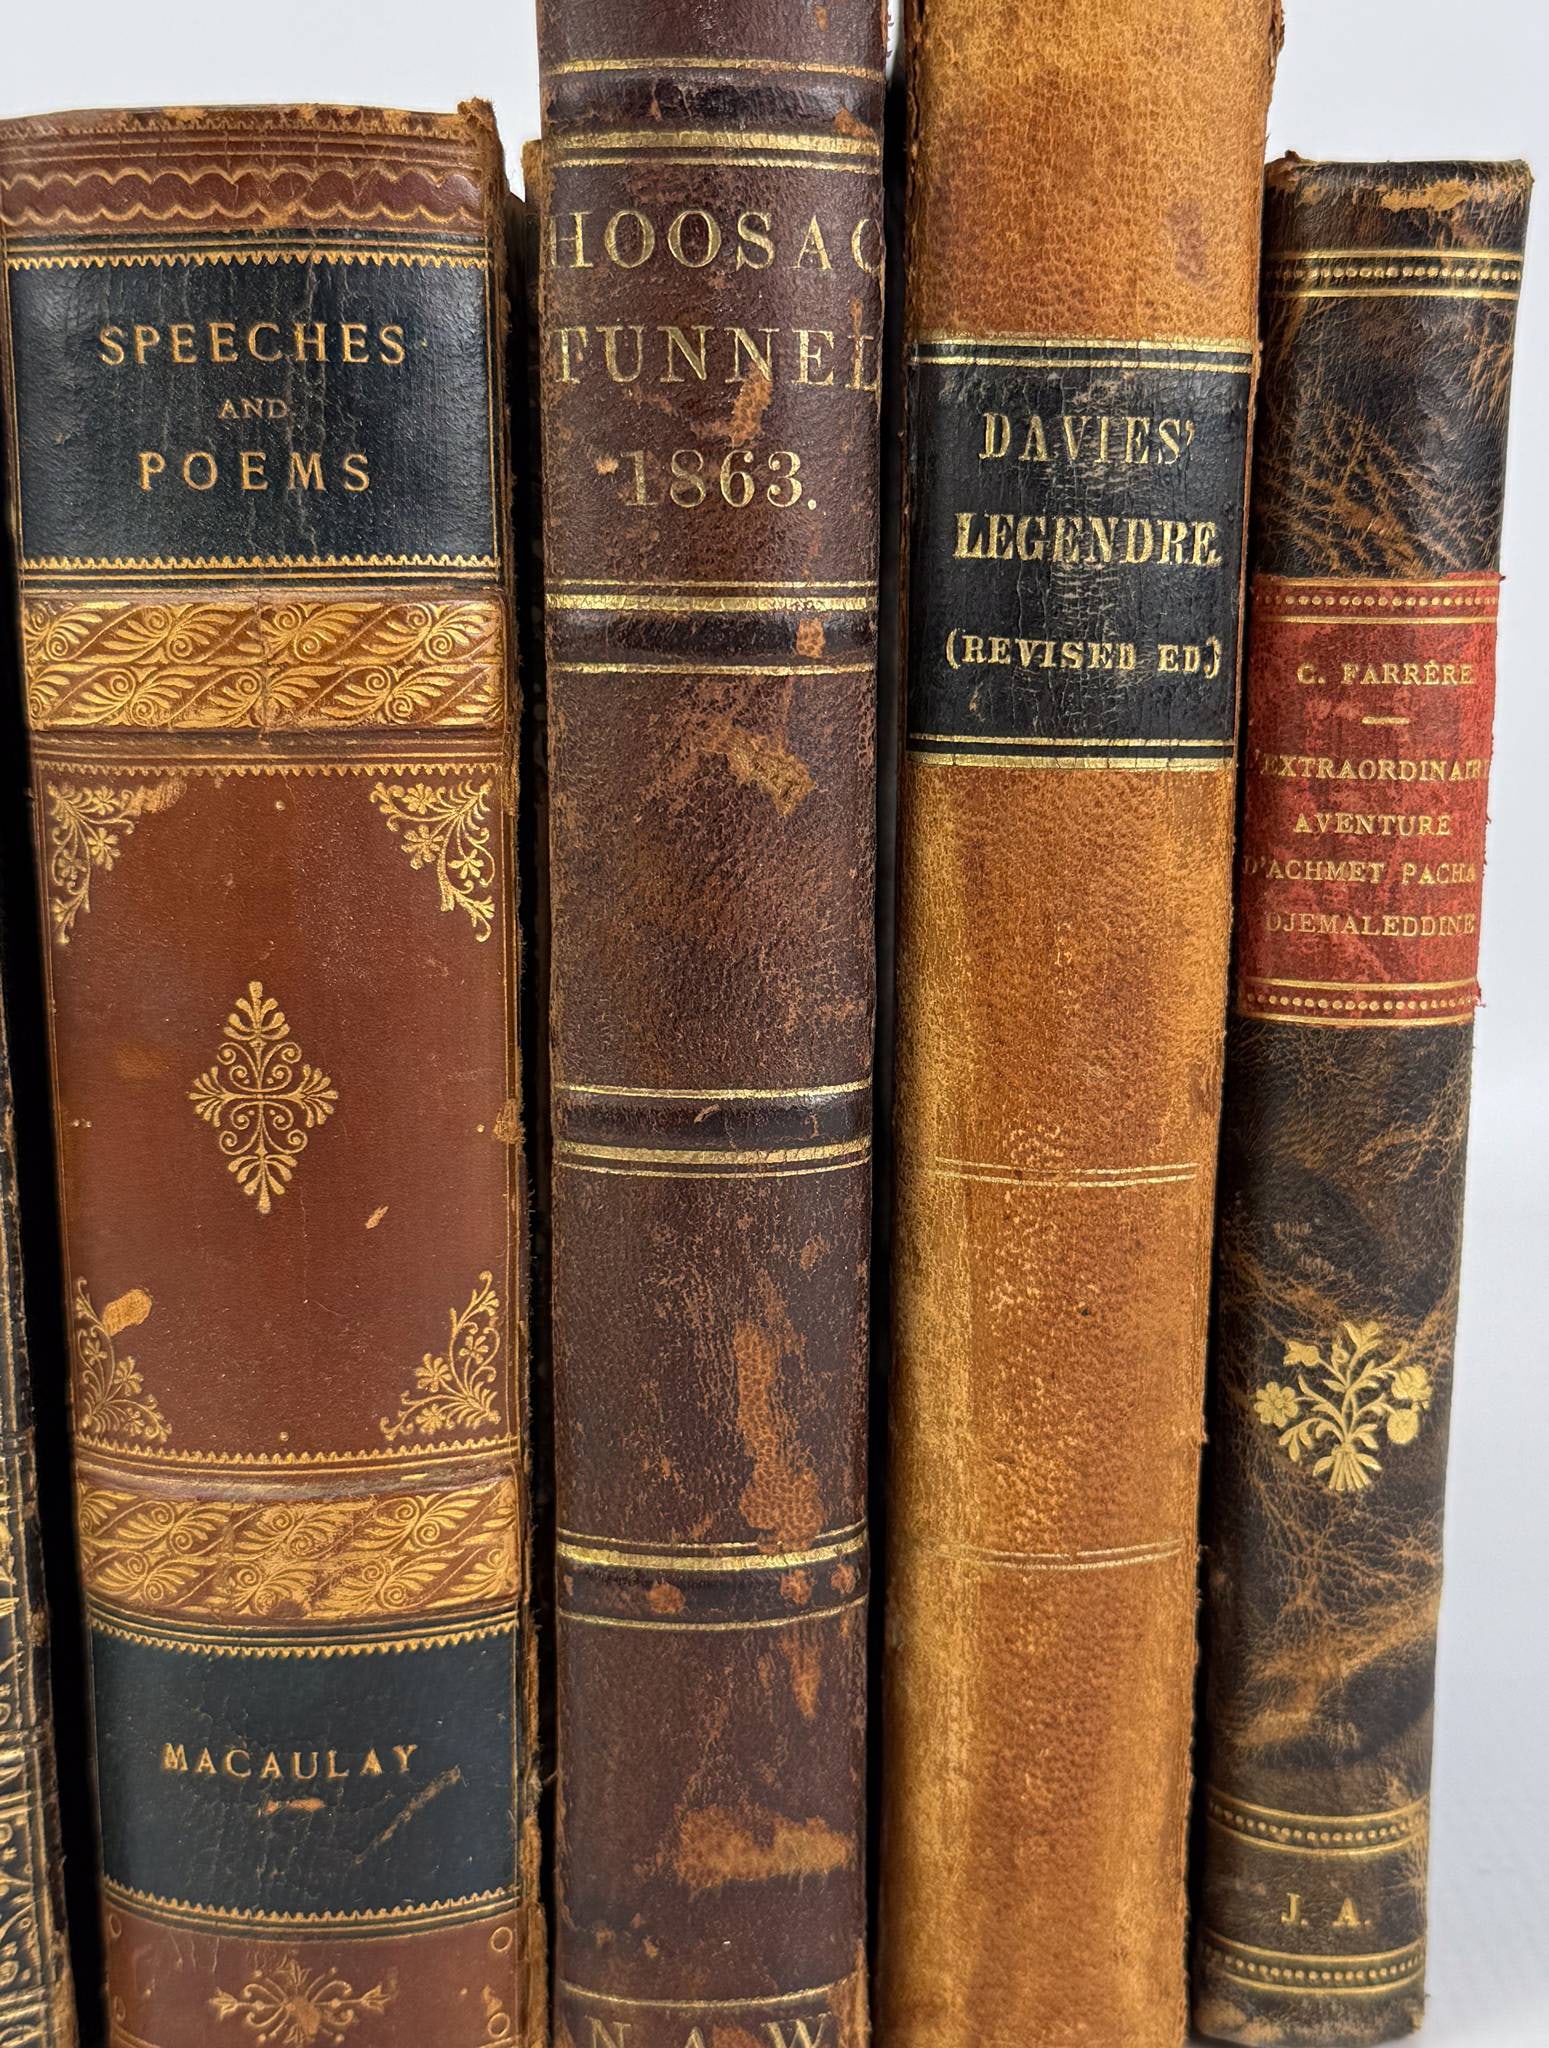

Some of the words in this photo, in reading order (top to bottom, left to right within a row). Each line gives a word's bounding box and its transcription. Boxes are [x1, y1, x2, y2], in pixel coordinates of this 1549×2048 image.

[548, 209, 882, 276] HOOSAC
[99, 322, 407, 366] SPEECHES
[551, 325, 878, 392] TUNNEL
[217, 398, 289, 420] AND
[138, 451, 371, 492] POEMS
[621, 449, 818, 511] 1863.
[952, 512, 1223, 568] LEGENDRE
[945, 627, 1136, 670] (REVISED
[1156, 635, 1223, 680] ED)
[1296, 664, 1326, 685] C.
[1292, 811, 1452, 837] AVENTURE
[1401, 862, 1476, 885] PACHA
[161, 1743, 418, 1780] MACAULAY
[1280, 1892, 1309, 1927] J.
[1331, 1897, 1372, 1927] A.
